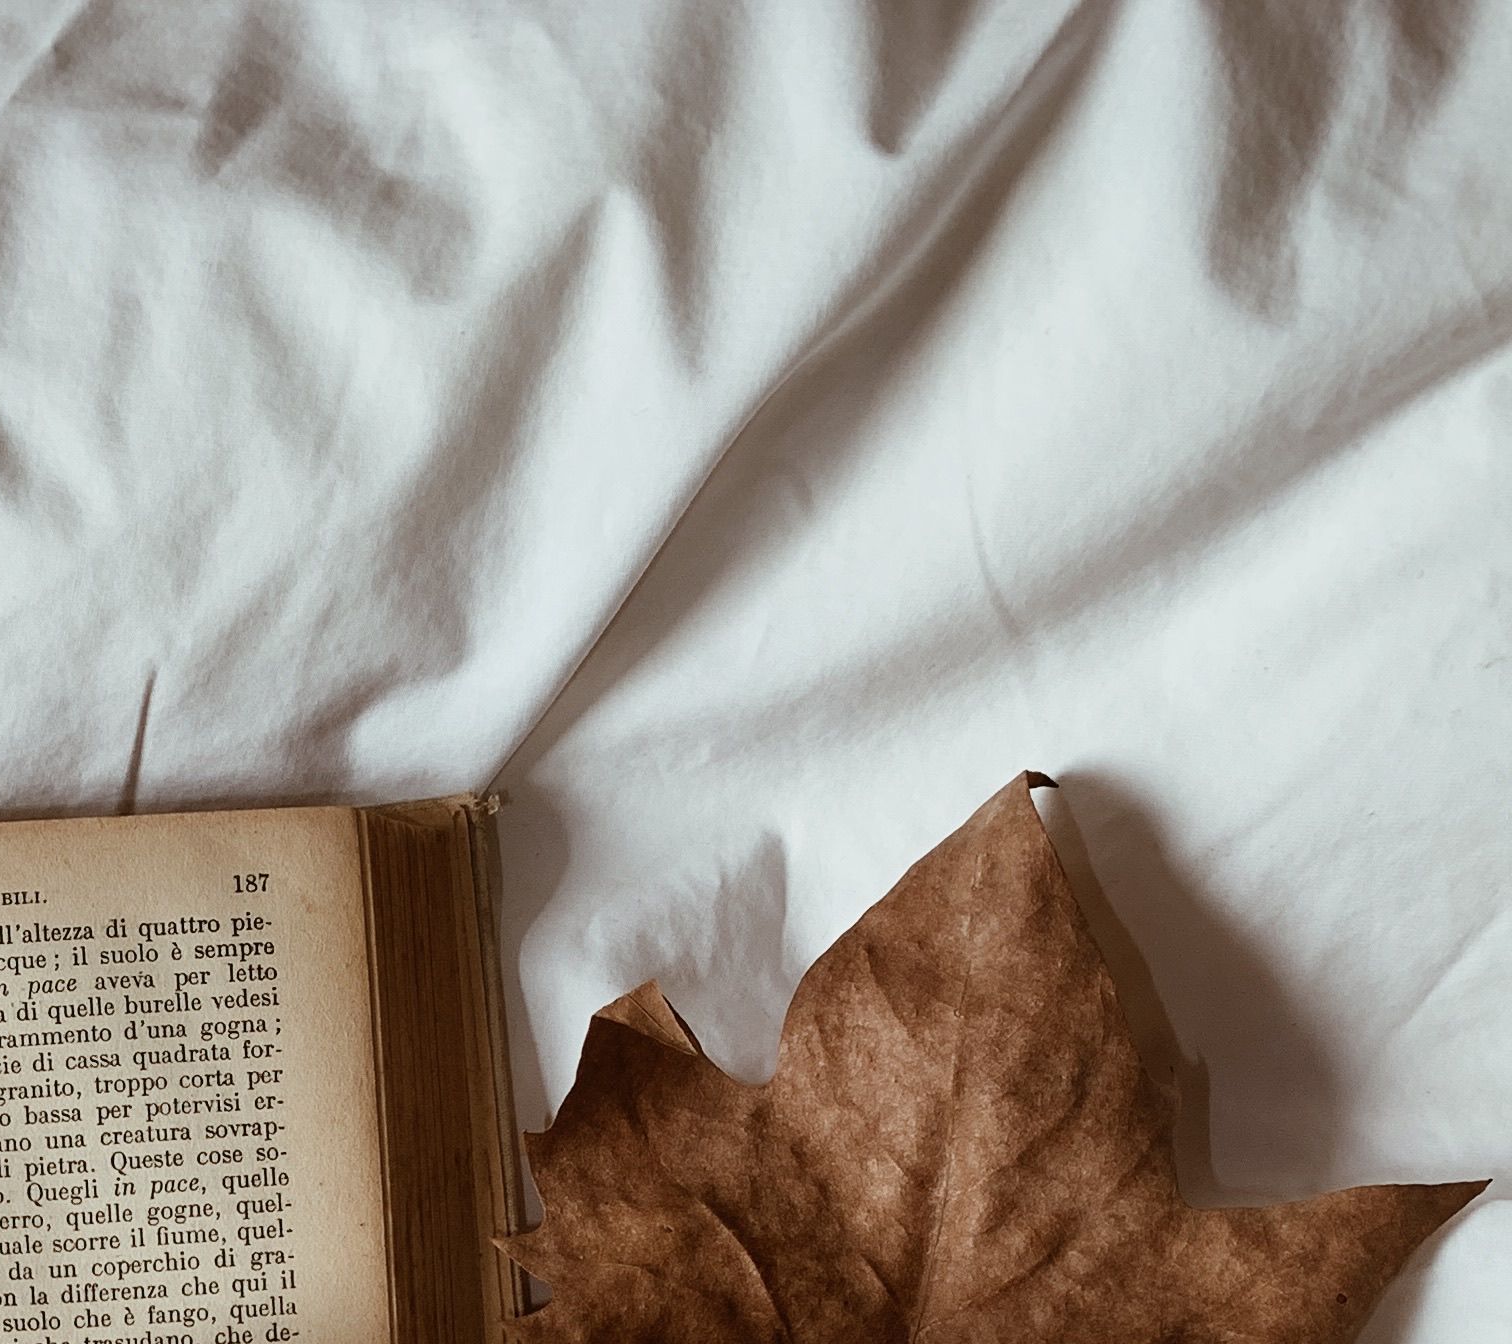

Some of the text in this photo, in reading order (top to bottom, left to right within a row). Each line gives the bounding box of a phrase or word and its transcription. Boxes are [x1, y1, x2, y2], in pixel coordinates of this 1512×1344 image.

[234, 873, 269, 893] 187
[105, 919, 127, 938] di
[139, 917, 220, 942] quattro
[231, 912, 271, 936] pie-
[17, 1001, 41, 1021] di
[48, 997, 114, 1024] quelle
[124, 992, 201, 1014] burelle
[211, 987, 279, 1010] vedesi
[215, 1326, 256, 1344] che
[266, 1323, 299, 1342] de-
